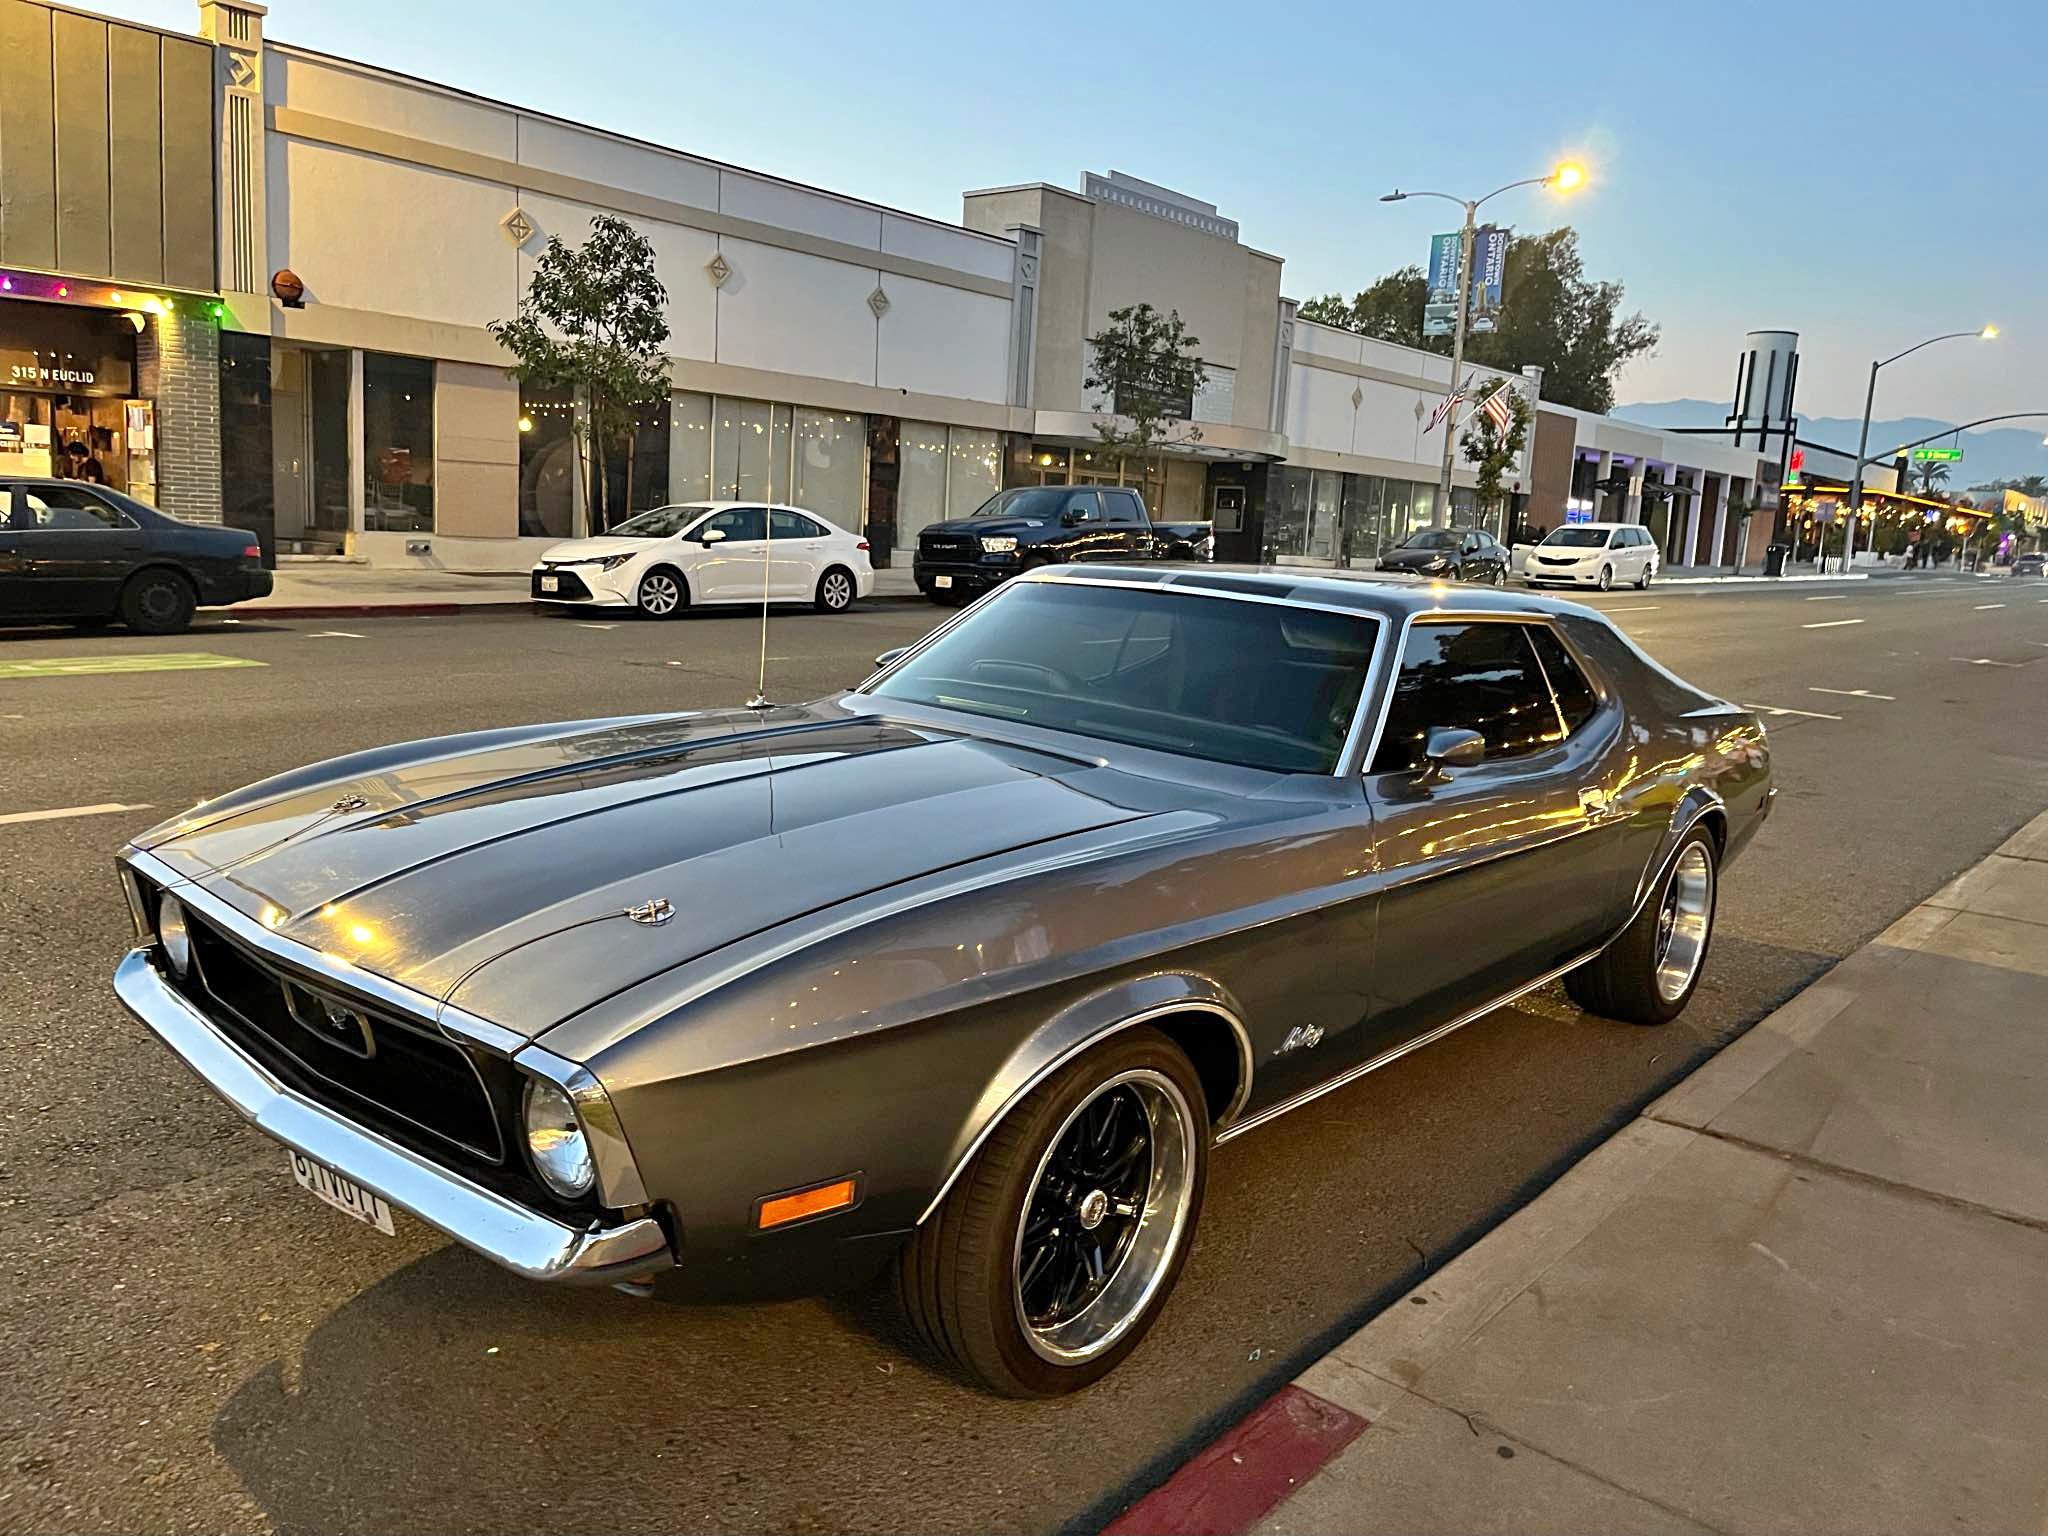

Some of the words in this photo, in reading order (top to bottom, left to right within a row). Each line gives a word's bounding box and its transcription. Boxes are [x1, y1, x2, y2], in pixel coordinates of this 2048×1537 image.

[1438, 237, 1451, 288] ONTARIO
[1446, 236, 1458, 289] DOWNTOWN
[1484, 233, 1498, 286] ONTARIO
[1493, 232, 1505, 286] DOWNTOWN
[11, 365, 37, 379] 315
[40, 368, 49, 380] N
[52, 369, 95, 384] EUCLID
